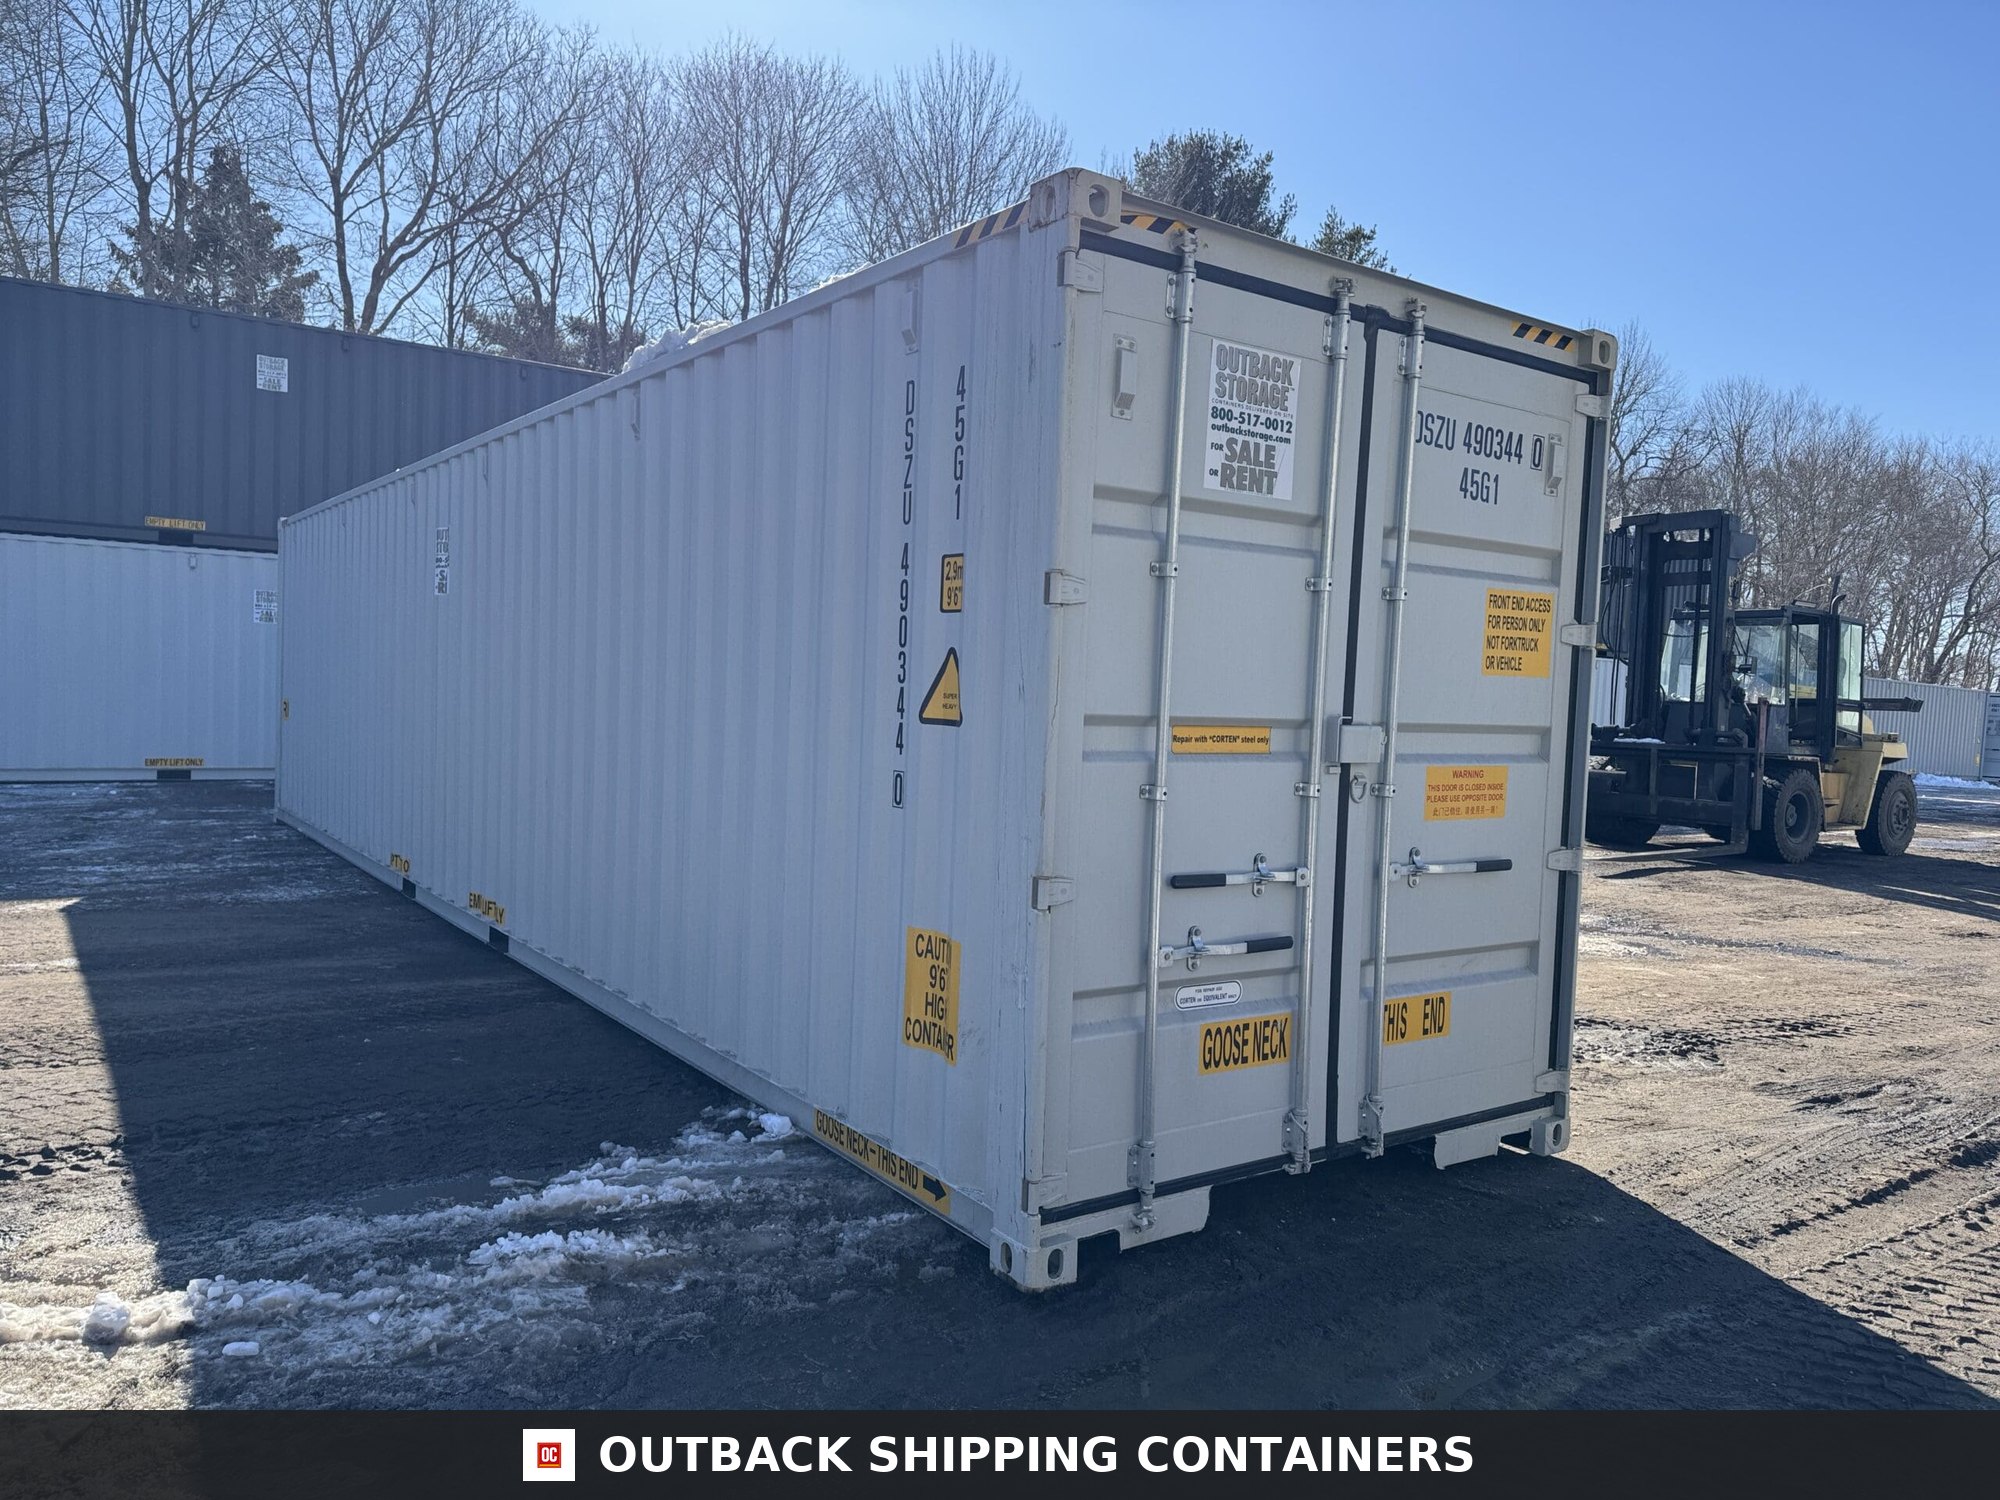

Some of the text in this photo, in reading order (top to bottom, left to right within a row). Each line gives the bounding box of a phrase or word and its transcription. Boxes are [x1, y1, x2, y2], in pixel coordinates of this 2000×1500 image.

[1216, 344, 1294, 386] OUTBACK
[1215, 372, 1289, 411] STORAGE
[1211, 398, 1244, 409] CONTAINERS
[1245, 405, 1273, 415] DELIVERED
[1211, 406, 1293, 434] 800-517-0012
[953, 365, 966, 520] 45G1
[1211, 422, 1291, 444] outbackstorage.com
[1211, 437, 1276, 470] FOR SALE
[1463, 422, 1523, 464] 490344
[1532, 437, 1542, 468] 0
[1209, 469, 1219, 477] OR
[1220, 462, 1278, 495] RENT
[1459, 467, 1499, 505] 45G1
[894, 380, 915, 806] DSZU 490344 0
[1489, 594, 1551, 613] FRONT END ACCESS
[1488, 614, 1546, 633] FOR PERSON ONLY
[1486, 635, 1539, 652] NOT FORKTRUCK
[1485, 655, 1522, 671] OR VEHICLE
[942, 692, 957, 700] SUPER
[1173, 735, 1269, 745] Repair with "CORTEN" steel only
[145, 758, 204, 766] EMPTY LIFT ONLY
[1452, 770, 1484, 778] WARNING
[1464, 783, 1486, 791] CLOSED
[1427, 795, 1448, 803] PLEASE
[1461, 794, 1487, 802] OPPOSITE
[1203, 993, 1228, 1002] EQUIVALENT
[1422, 996, 1446, 1036] END
[1202, 1017, 1288, 1070] GOOSE NECK
[816, 1110, 844, 1146] GOOSE
[899, 1157, 919, 1190] END
